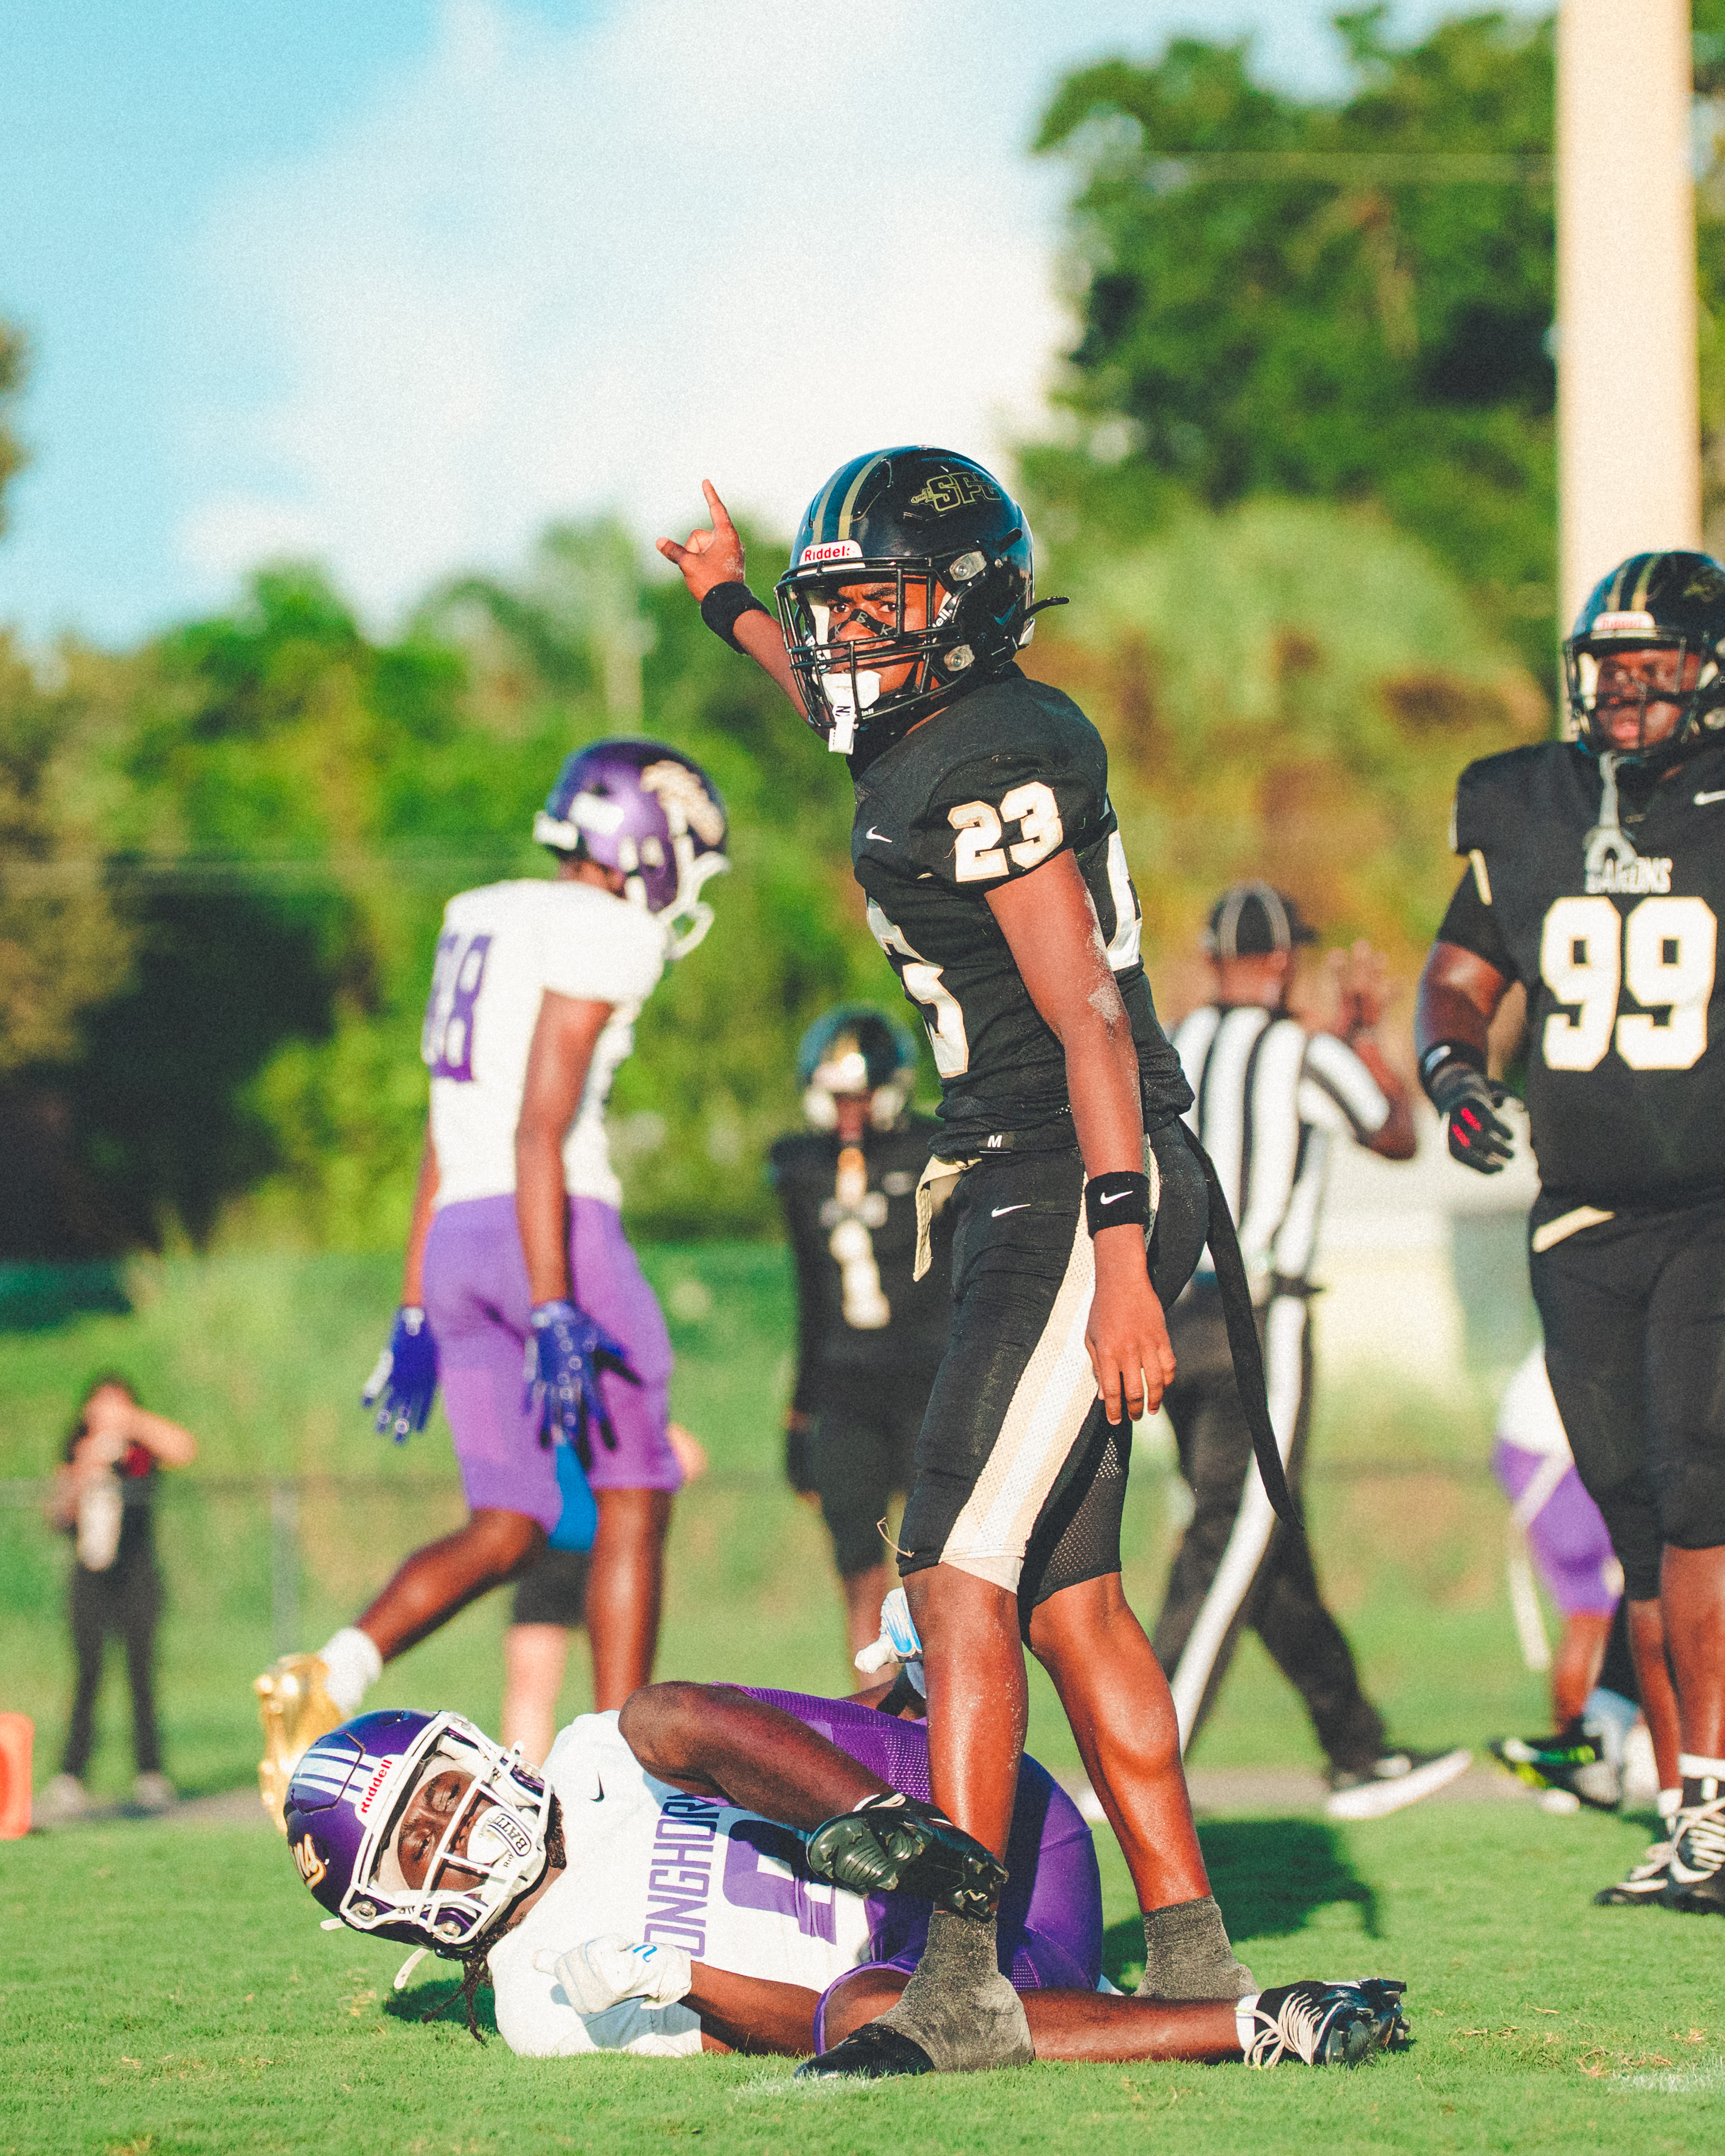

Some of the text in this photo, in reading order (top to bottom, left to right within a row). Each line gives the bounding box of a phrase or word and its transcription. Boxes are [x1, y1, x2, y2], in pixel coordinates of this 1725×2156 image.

[805, 545, 850, 562] Riddel
[947, 781, 1063, 883] 23
[1539, 896, 1718, 1071] 99
[361, 1759, 392, 1814] Riddell
